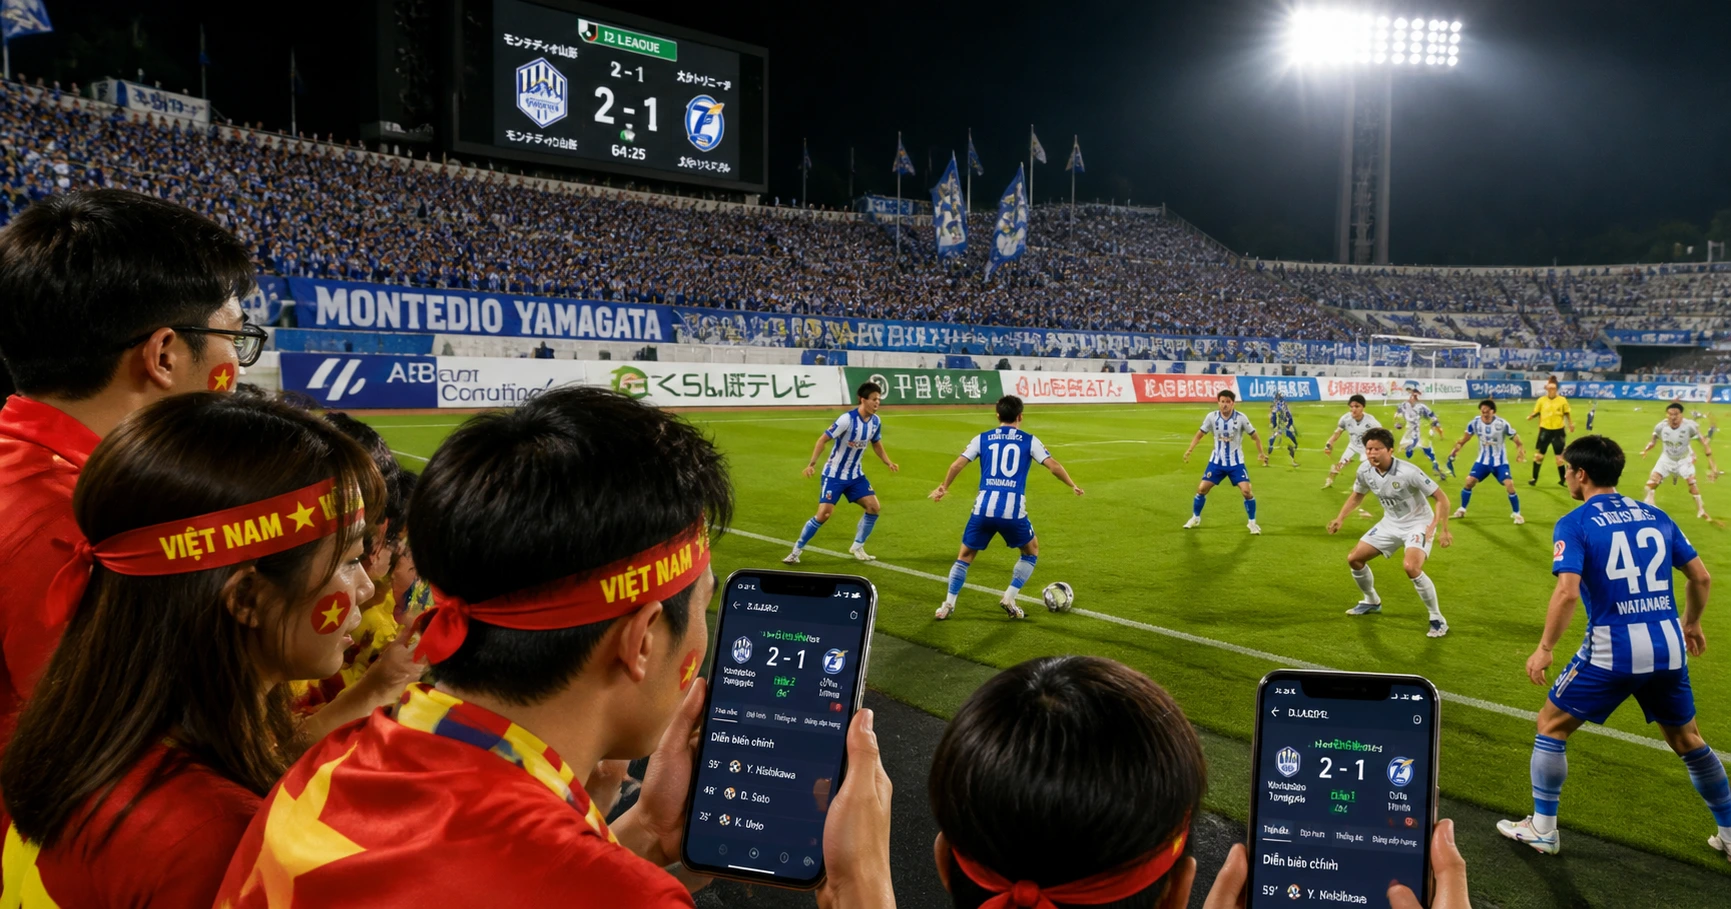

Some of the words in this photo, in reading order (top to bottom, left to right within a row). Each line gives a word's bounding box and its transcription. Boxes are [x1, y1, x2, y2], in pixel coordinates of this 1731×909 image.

[594, 86, 615, 125] 2
[644, 97, 658, 132] 1
[611, 144, 646, 161] 64:25
[315, 285, 503, 333] MONTEDIO
[513, 299, 663, 341] YAMAGATA
[988, 443, 1021, 478] 10
[159, 526, 216, 561] VIỆT
[222, 512, 284, 549] NAM
[600, 565, 651, 603] VIỆT
[655, 543, 693, 586] NAM
[1605, 527, 1669, 594] 42
[1616, 595, 1672, 615] WATANABE
